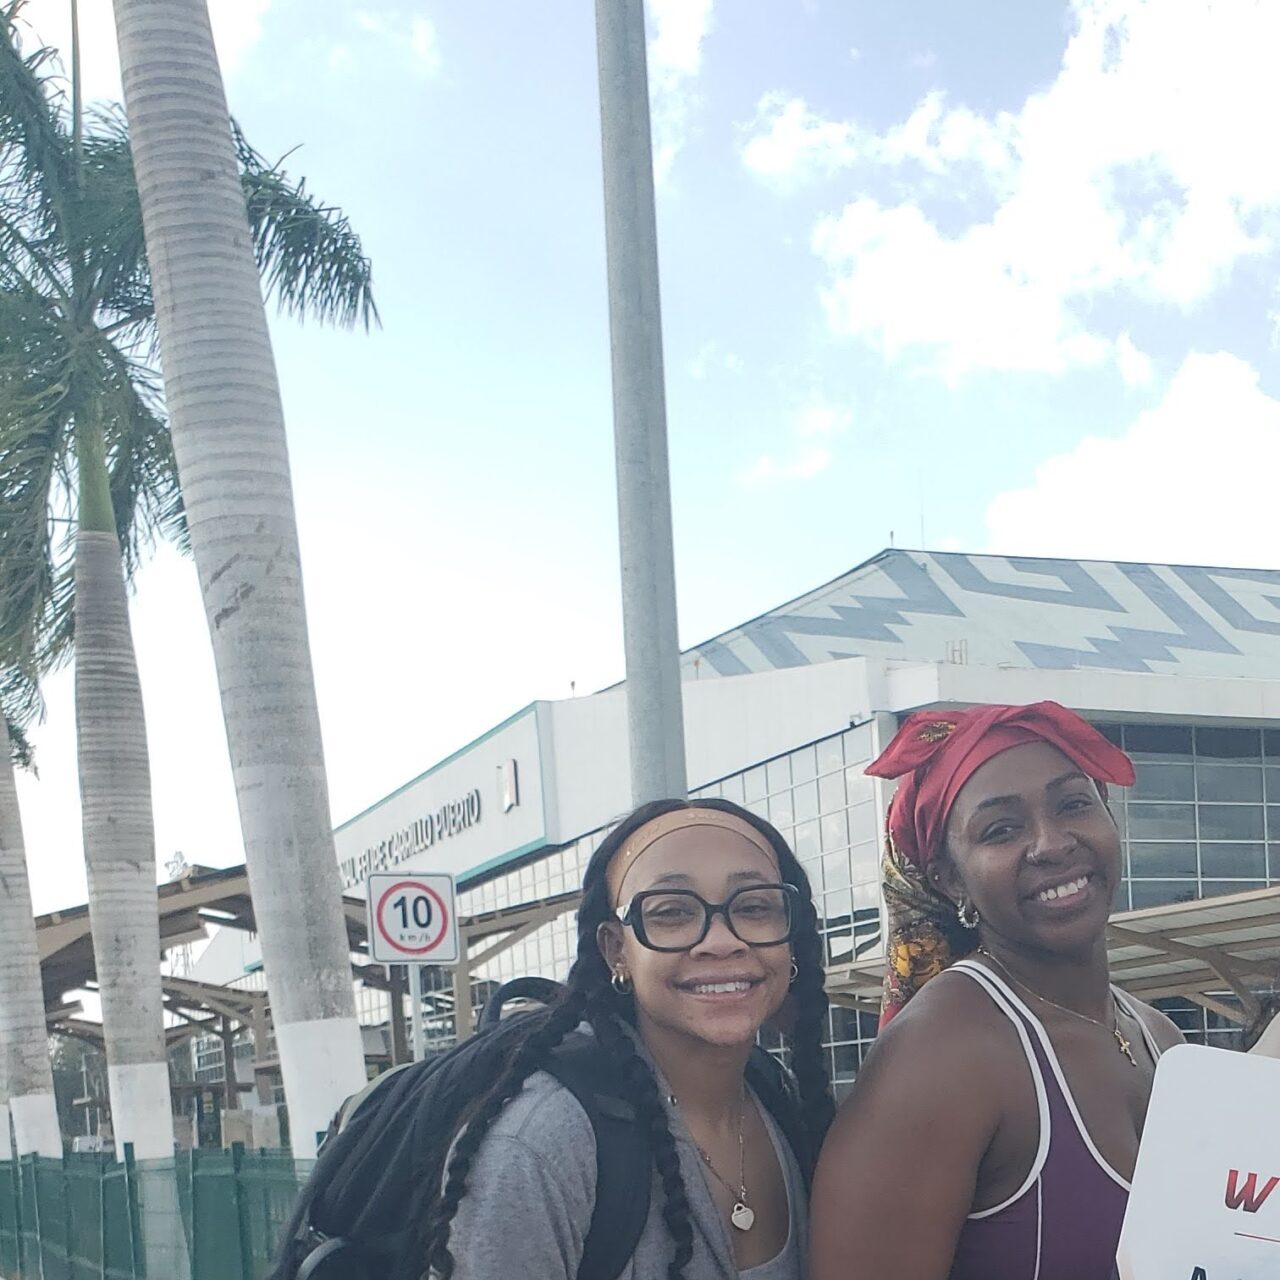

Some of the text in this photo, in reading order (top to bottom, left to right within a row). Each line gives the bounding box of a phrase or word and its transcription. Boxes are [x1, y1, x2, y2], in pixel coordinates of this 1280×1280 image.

[388, 814, 434, 866] CARRILLO
[436, 788, 481, 840] PUERTO
[393, 895, 433, 929] 10
